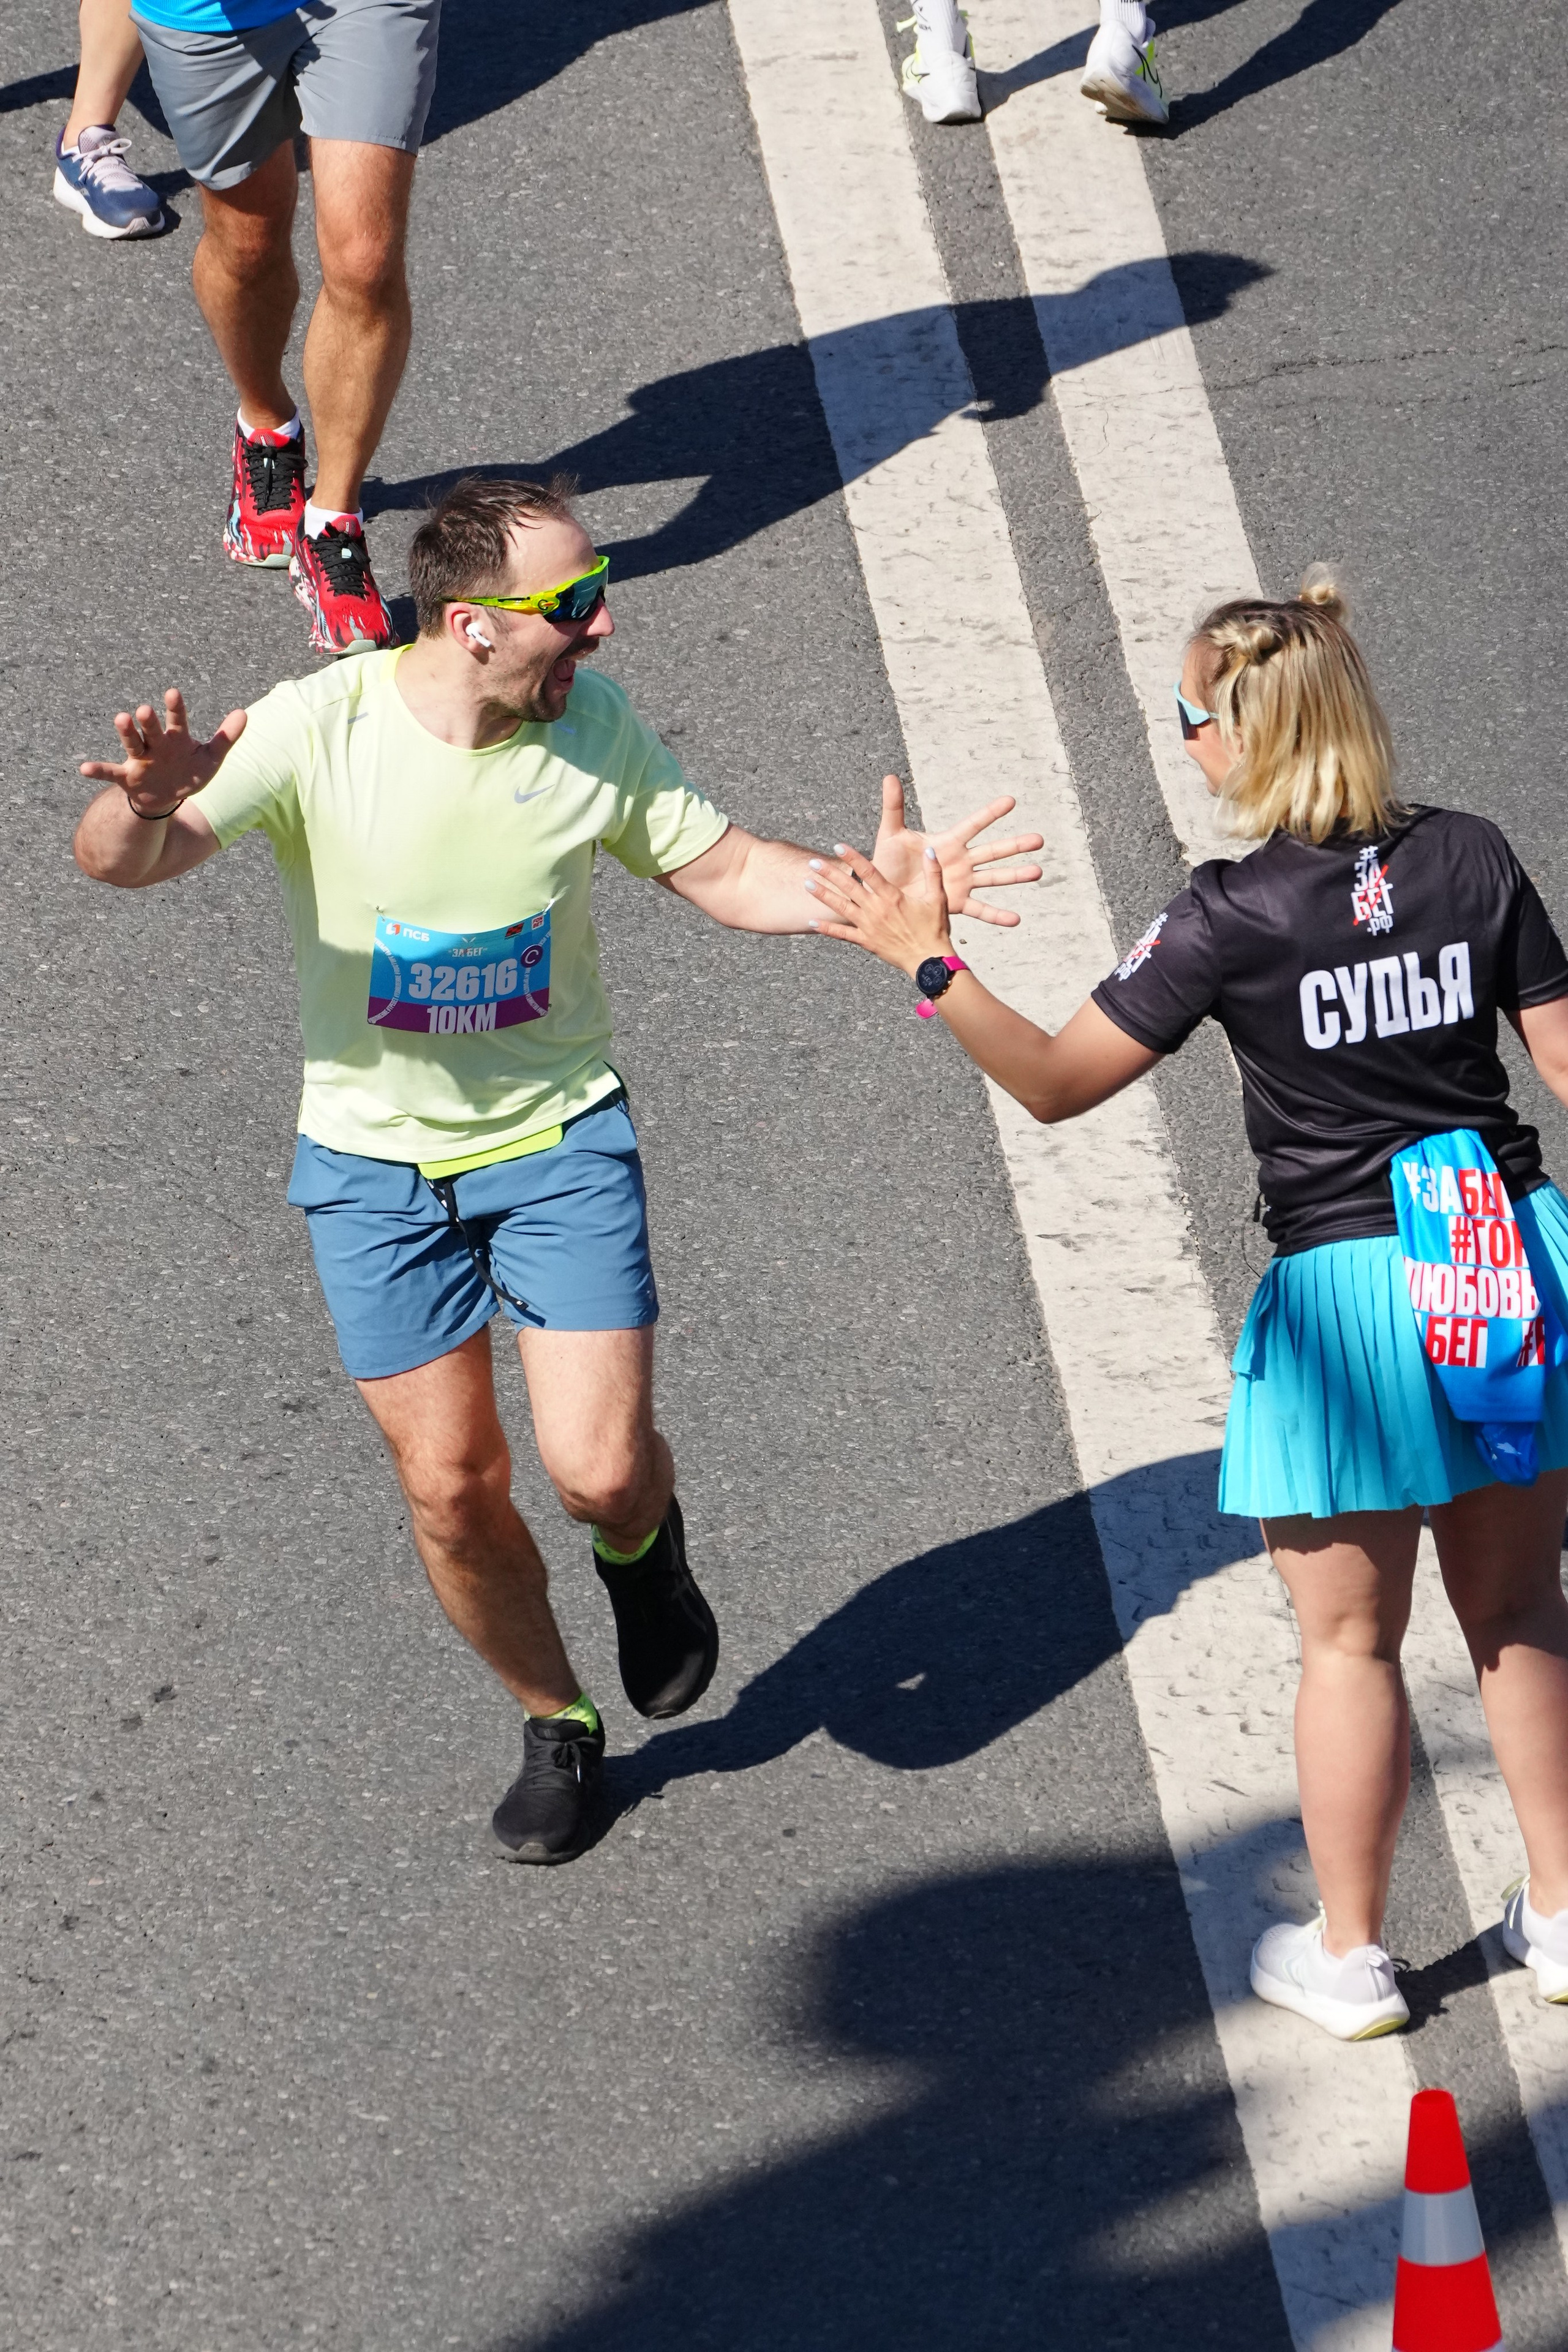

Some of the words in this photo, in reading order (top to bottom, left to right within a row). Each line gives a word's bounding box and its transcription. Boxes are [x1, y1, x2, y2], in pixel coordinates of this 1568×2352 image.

[403, 927, 430, 942] ПСБ
[409, 958, 518, 1001] 32616
[1299, 941, 1474, 1049] СУДЬЯ
[1414, 1311, 1487, 1368] БЕГ
